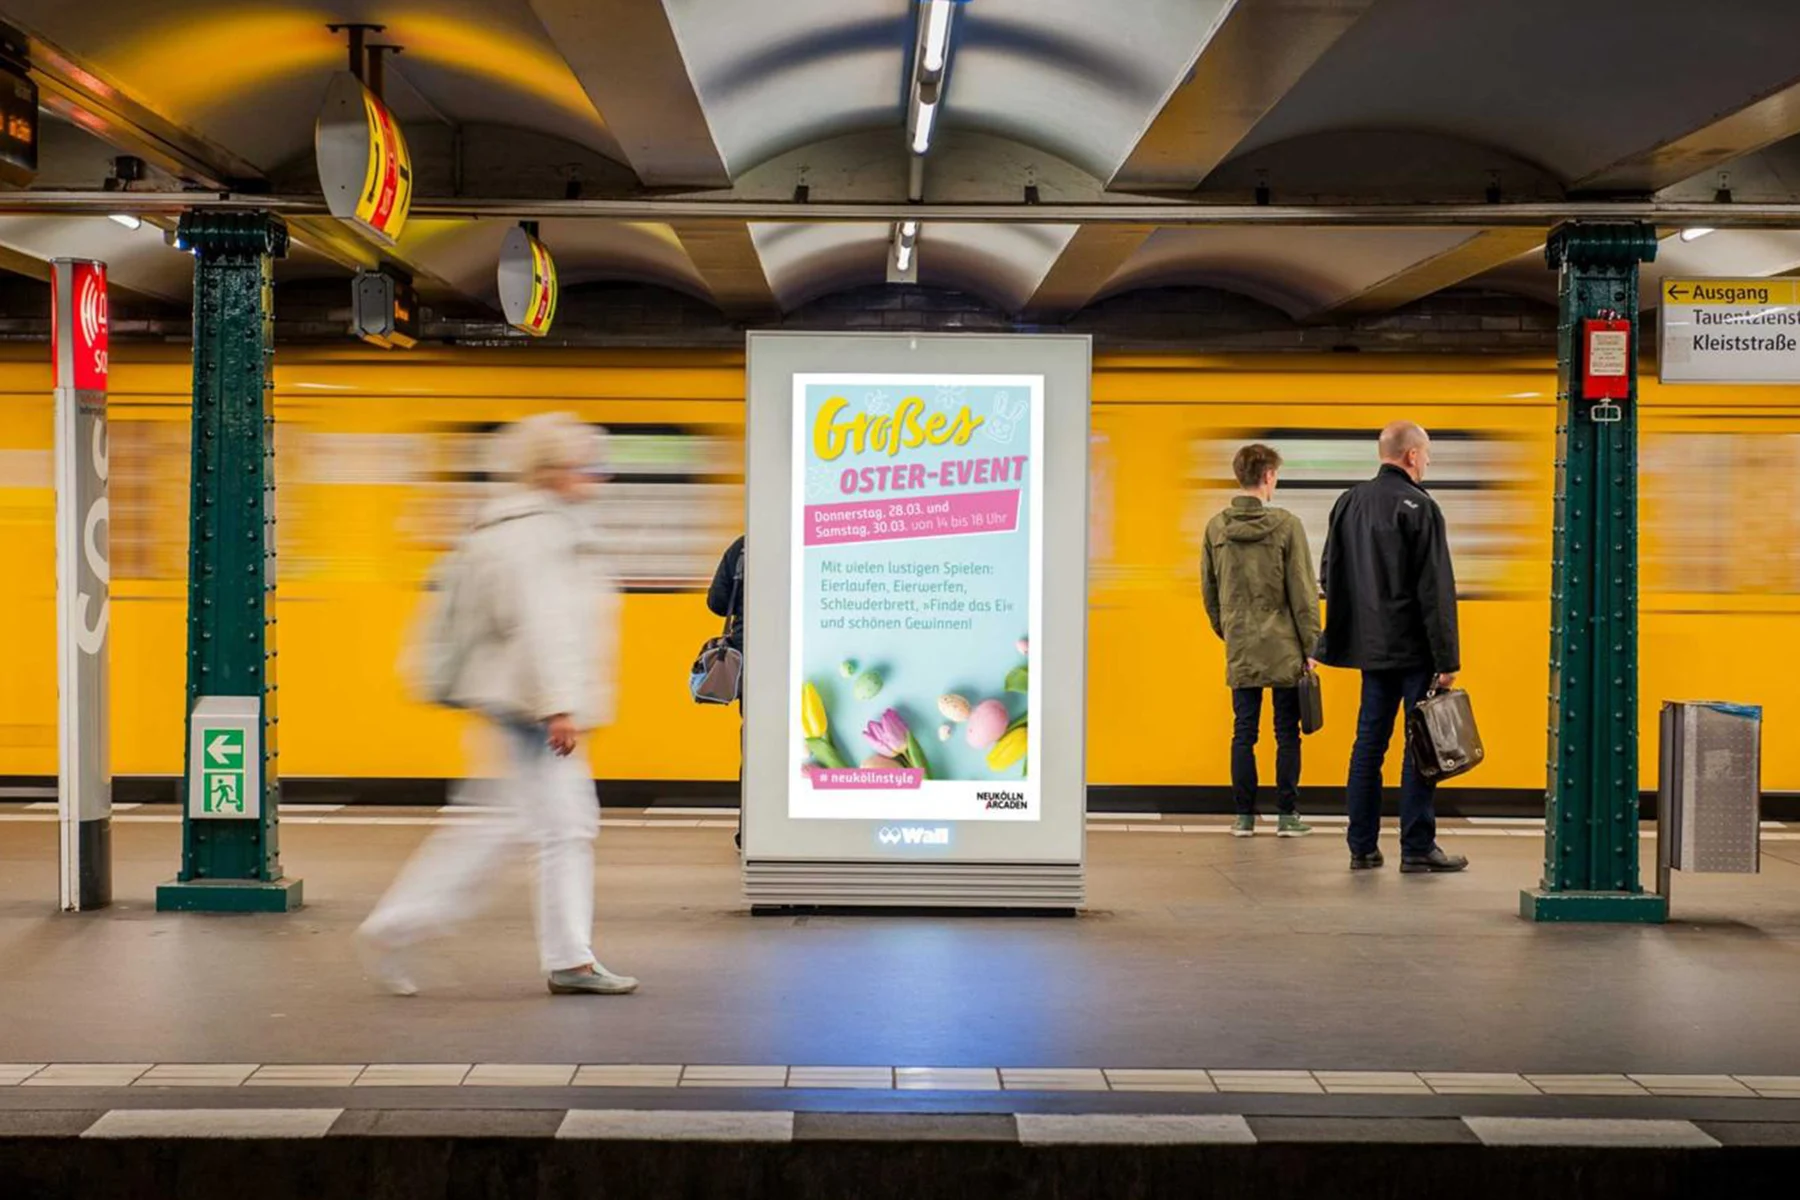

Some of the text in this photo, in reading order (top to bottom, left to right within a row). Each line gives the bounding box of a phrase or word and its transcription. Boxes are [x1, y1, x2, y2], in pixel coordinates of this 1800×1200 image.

[1693, 284, 1768, 304] Ausgang
[1693, 333, 1797, 351] Kleiststraße
[813, 395, 985, 461] Großes
[840, 455, 1028, 495] OSTER-EVENT
[888, 503, 925, 518] 28.03.
[926, 500, 950, 515] und
[872, 519, 908, 534] 30.03.
[911, 520, 934, 531] von
[936, 516, 949, 529] 14
[951, 515, 969, 528] bis
[971, 512, 984, 526] 18
[986, 511, 1008, 525] Uhr
[821, 560, 994, 577] Mit vielen lustigen Spielen:
[821, 579, 968, 595] Eierlaufen, Eierwerfen,
[820, 597, 919, 613] Schleuderbrett,
[968, 600, 992, 612] das
[820, 616, 973, 630] und schönen Gewinnen!
[830, 771, 914, 786] neuköllnstyle
[976, 790, 1024, 800] NEUKÖLLN
[985, 800, 1028, 810] ARCADEN
[901, 827, 949, 844] Wall
